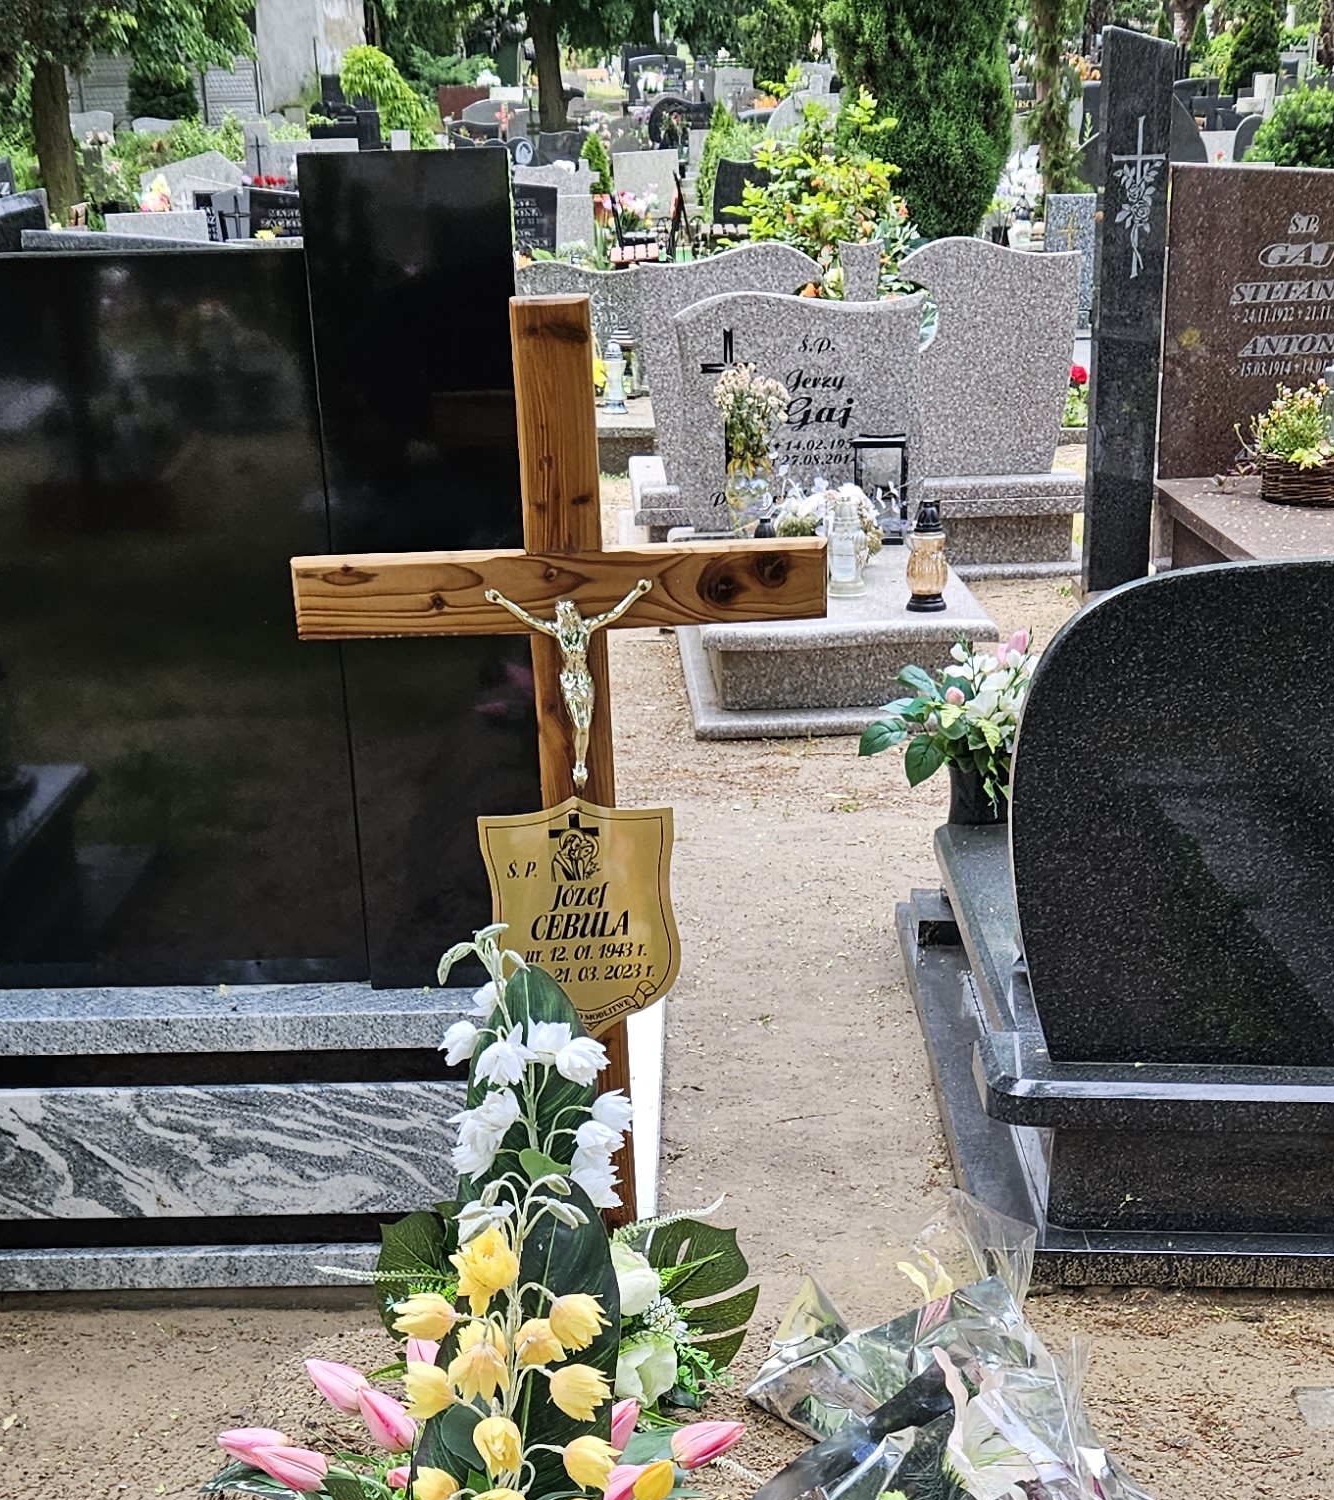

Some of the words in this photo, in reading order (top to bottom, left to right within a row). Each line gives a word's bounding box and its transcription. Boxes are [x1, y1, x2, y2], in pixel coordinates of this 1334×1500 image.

[1243, 306, 1295, 324] 24.11.1922
[785, 368, 846, 394] Jerzy
[784, 396, 859, 431] Gaj
[785, 438, 854, 452] 14.02.195
[782, 452, 854, 467] 27.08.201
[549, 882, 610, 912] Józef
[531, 910, 629, 942] CEBULA
[598, 942, 633, 960] 1943
[604, 963, 641, 980] 2023
